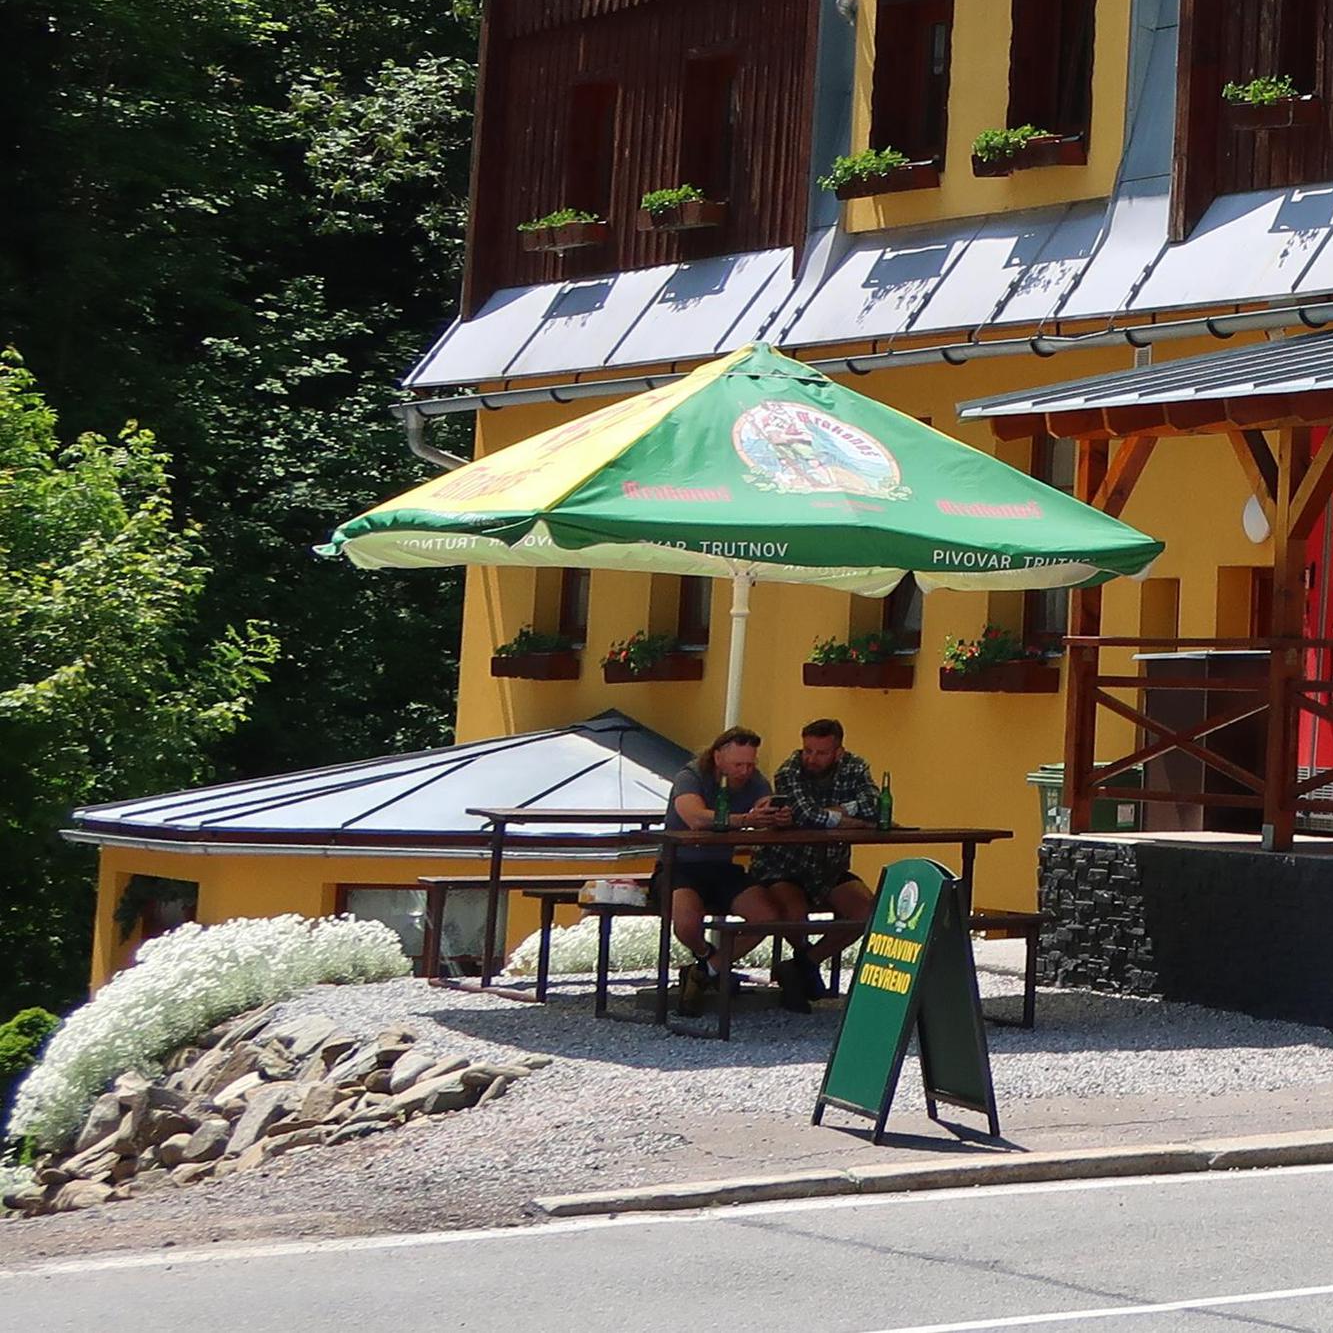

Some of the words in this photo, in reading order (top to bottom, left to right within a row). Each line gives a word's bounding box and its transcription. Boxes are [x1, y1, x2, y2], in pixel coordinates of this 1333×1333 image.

[699, 540, 789, 558] TRUTNOV
[933, 549, 1012, 569] PIVOVAR
[866, 932, 922, 964] POTRAVINY
[860, 963, 912, 995] OTEVŘENO
